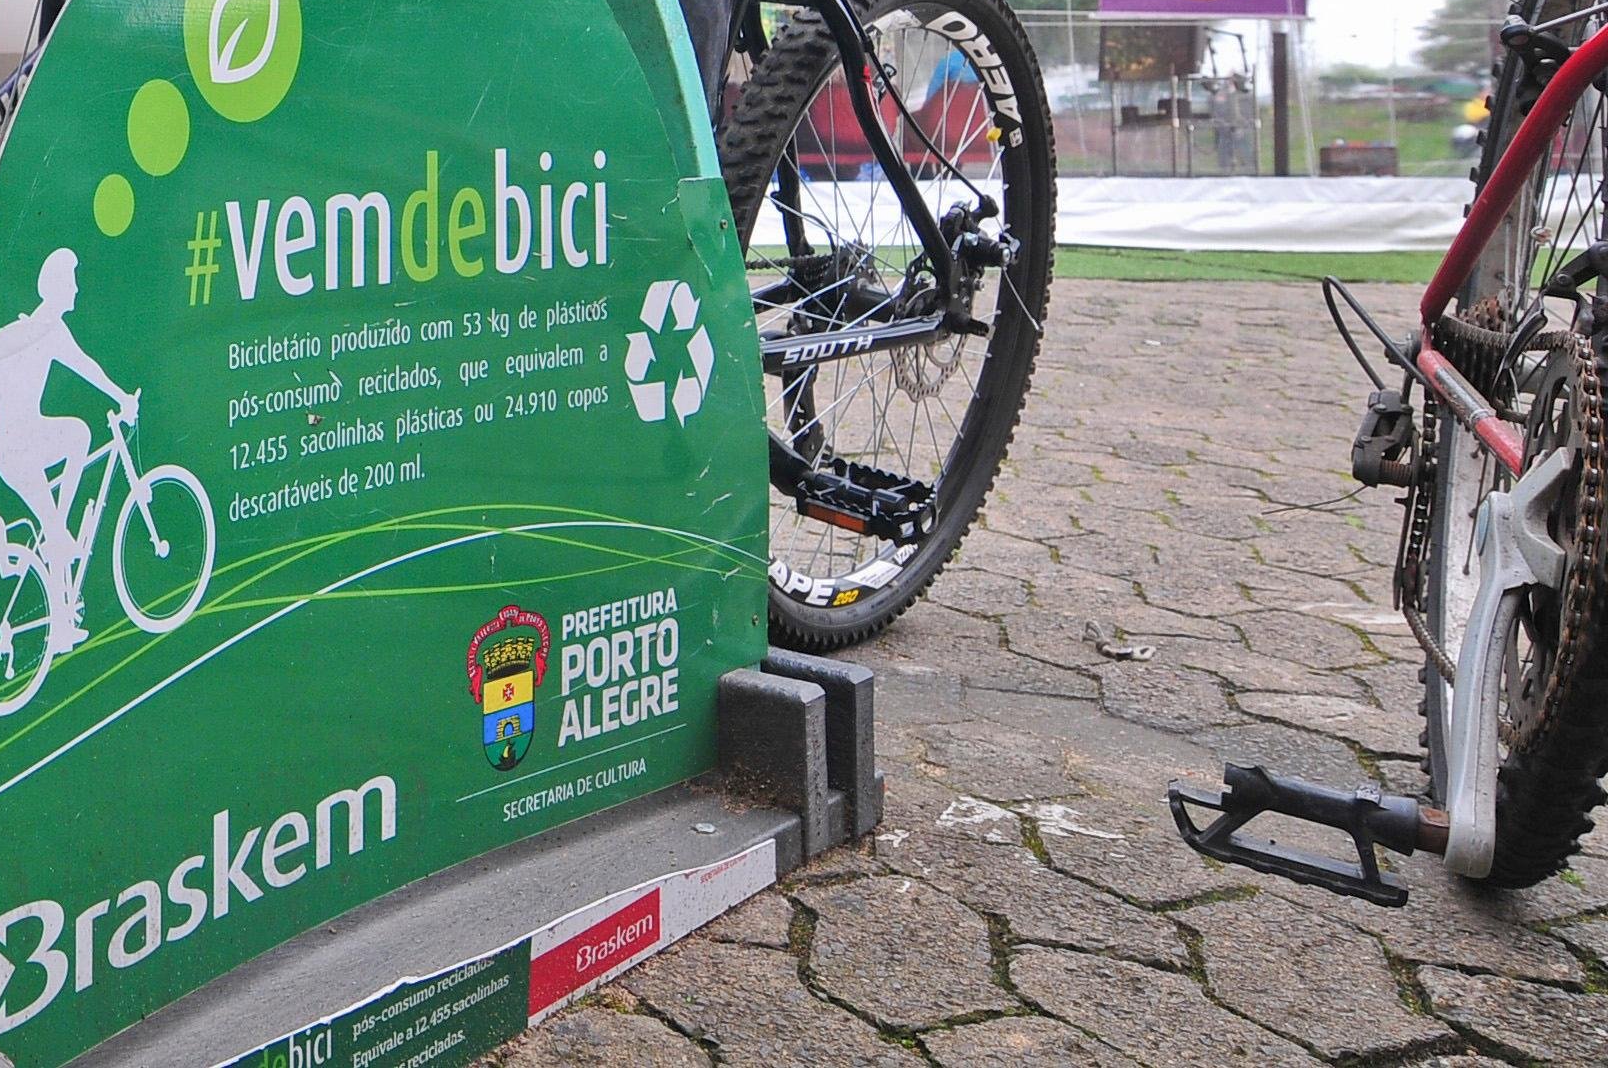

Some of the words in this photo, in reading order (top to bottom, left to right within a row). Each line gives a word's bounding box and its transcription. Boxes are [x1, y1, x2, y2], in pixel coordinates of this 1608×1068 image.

[925, 11, 1023, 124] AERO
[185, 148, 608, 307] #vemdebici
[228, 332, 321, 370] Bicicletário
[331, 319, 411, 360] produzido
[420, 318, 453, 341] com
[463, 312, 482, 337] 53
[490, 308, 509, 337] kg
[518, 304, 538, 330] de
[546, 299, 608, 332] plásticos
[782, 334, 873, 365] SOUTH
[228, 381, 340, 427] pós-consumo
[359, 362, 441, 396] reciclados,
[459, 359, 489, 386] que
[505, 344, 584, 378] equivalem
[599, 344, 608, 362] a
[229, 435, 288, 471] 12.455
[300, 418, 384, 456] sacolinhas
[397, 406, 463, 443] plásticas
[474, 403, 494, 423] ou
[505, 389, 557, 419] 24.910
[567, 385, 609, 412] copos
[229, 475, 332, 522] descartáveis
[339, 468, 359, 495] de
[364, 461, 394, 490] 200
[400, 453, 425, 482] ml.
[561, 587, 679, 641] PREFEITURA
[560, 618, 679, 696] PORTO
[557, 668, 679, 748] ALEGRE
[503, 782, 575, 822] SECRETARIA
[577, 778, 593, 796] DE
[595, 758, 647, 789] CULTURA
[576, 914, 653, 973] Braskem
[352, 984, 435, 1041] pós-consumo
[436, 959, 495, 994] reciclados.
[352, 1031, 404, 1068] Equivale
[405, 1027, 413, 1042] a
[415, 1003, 451, 1037] 12.455
[451, 974, 510, 1016] sacolinhas
[407, 1029, 466, 1068] recicladas.
